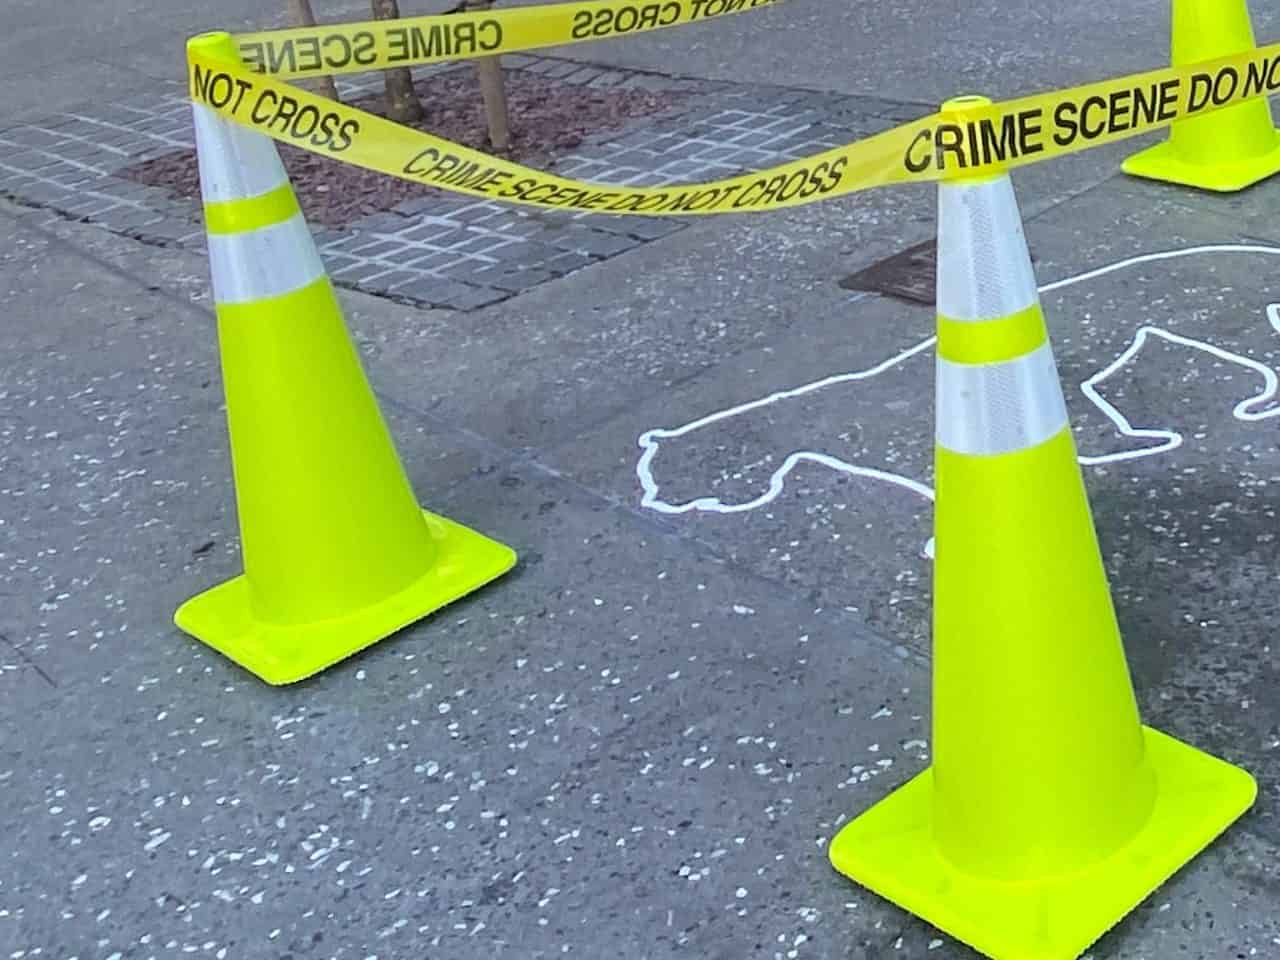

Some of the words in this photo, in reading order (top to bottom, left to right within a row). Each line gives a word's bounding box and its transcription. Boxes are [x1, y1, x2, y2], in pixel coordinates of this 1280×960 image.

[192, 63, 253, 115] NOT
[250, 89, 360, 152] CROSS
[904, 108, 1043, 174] CRIME
[1052, 78, 1181, 145] SCENE
[1187, 66, 1239, 114] DO
[402, 147, 504, 192] CRIME
[498, 178, 614, 210] SCENE
[605, 193, 671, 212] DO
[665, 184, 742, 212] NOT
[731, 156, 848, 209] CROSS
